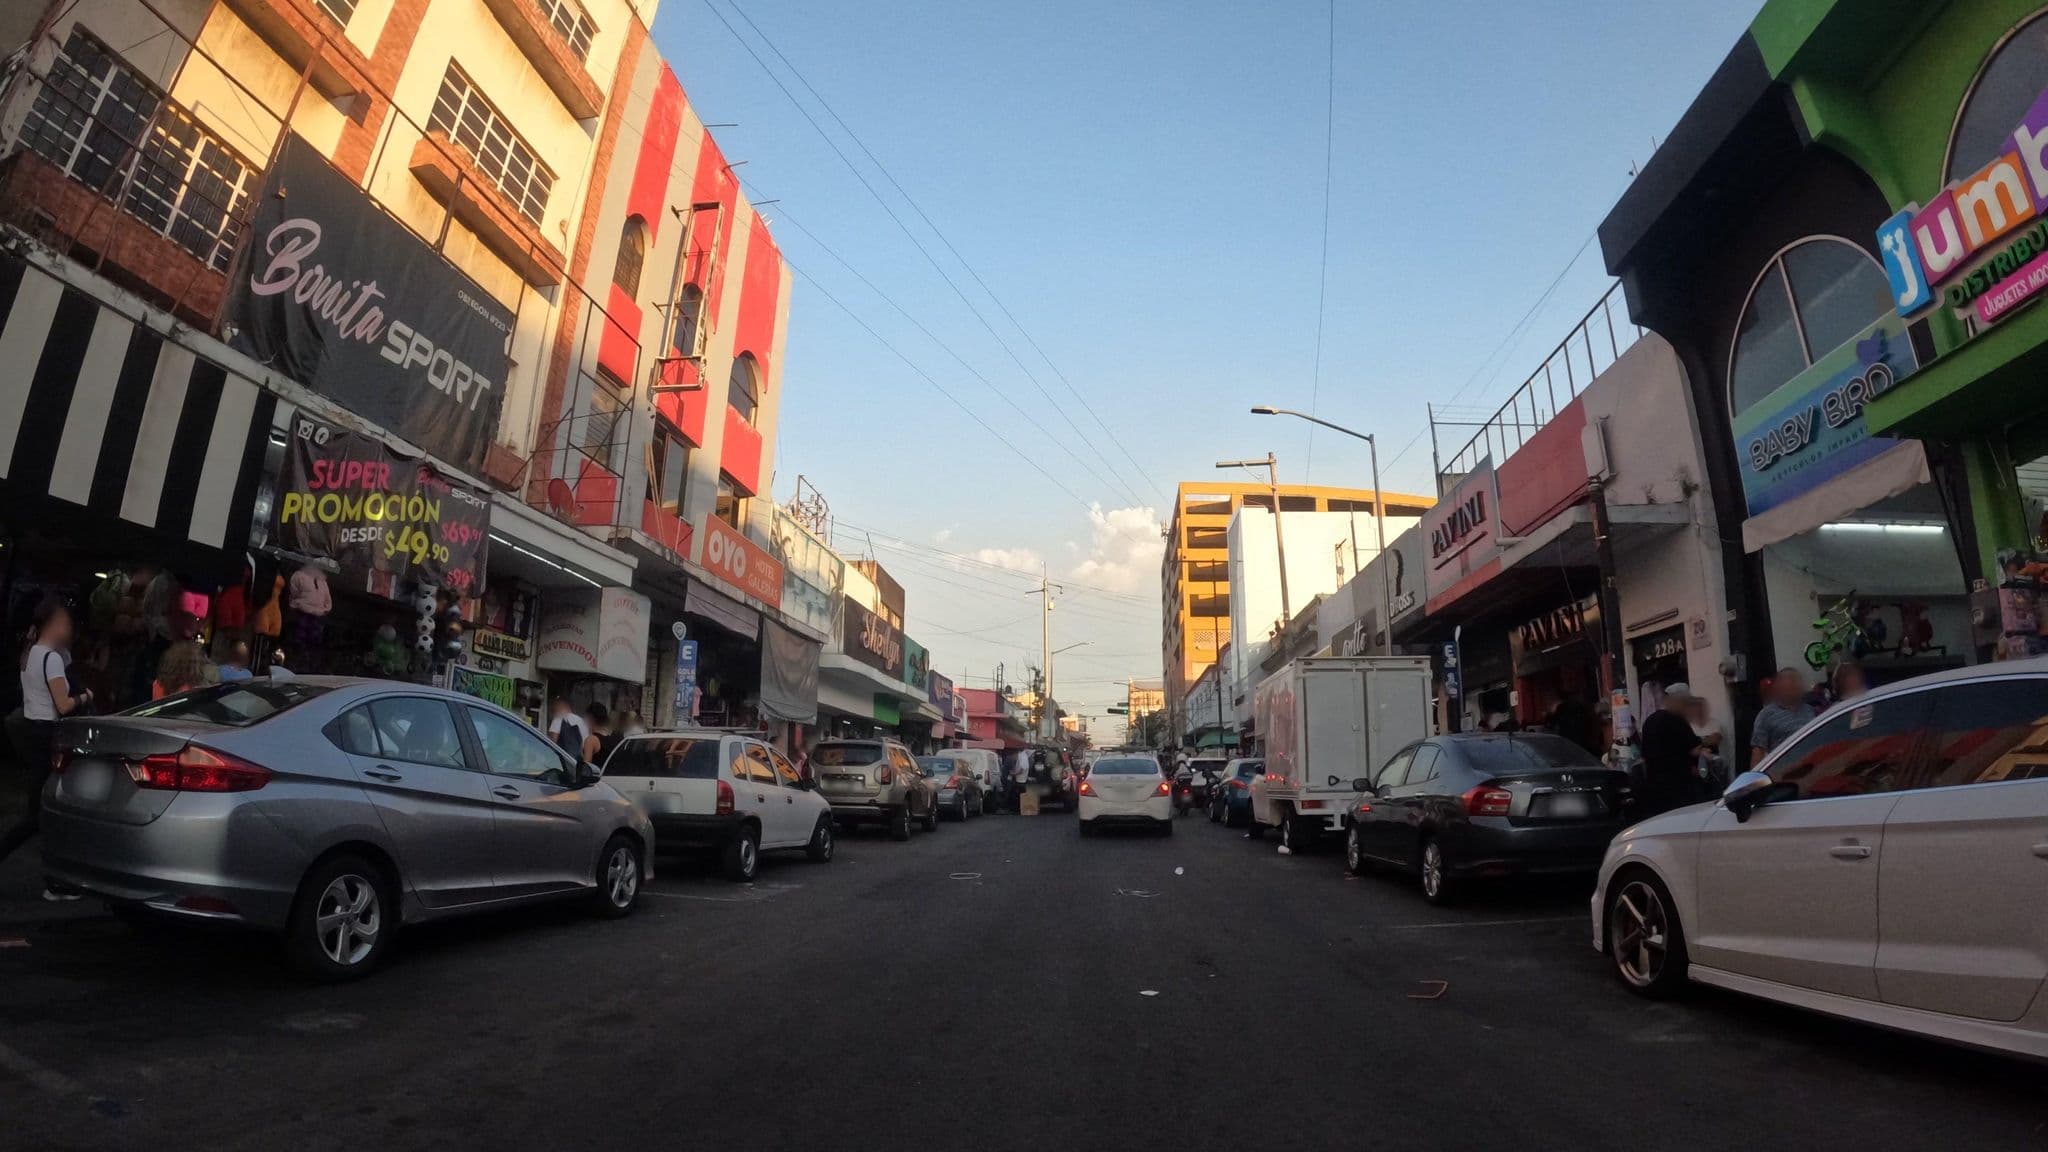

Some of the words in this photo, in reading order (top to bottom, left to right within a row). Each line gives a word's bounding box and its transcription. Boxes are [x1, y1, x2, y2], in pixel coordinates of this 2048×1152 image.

[1950, 216, 2048, 308] DISTRIBU
[251, 218, 387, 345] Bonita
[380, 319, 491, 412] SPORT
[1984, 279, 2029, 316] JUGUETES
[1749, 404, 1813, 474] BABY
[307, 459, 391, 490] SUPER
[280, 489, 441, 524] PROMOCIÓN
[451, 487, 488, 510] SPORT
[340, 526, 383, 543] DESDE
[1431, 489, 1485, 559] PAVINI
[708, 529, 747, 578] OYO
[681, 645, 693, 660] E
